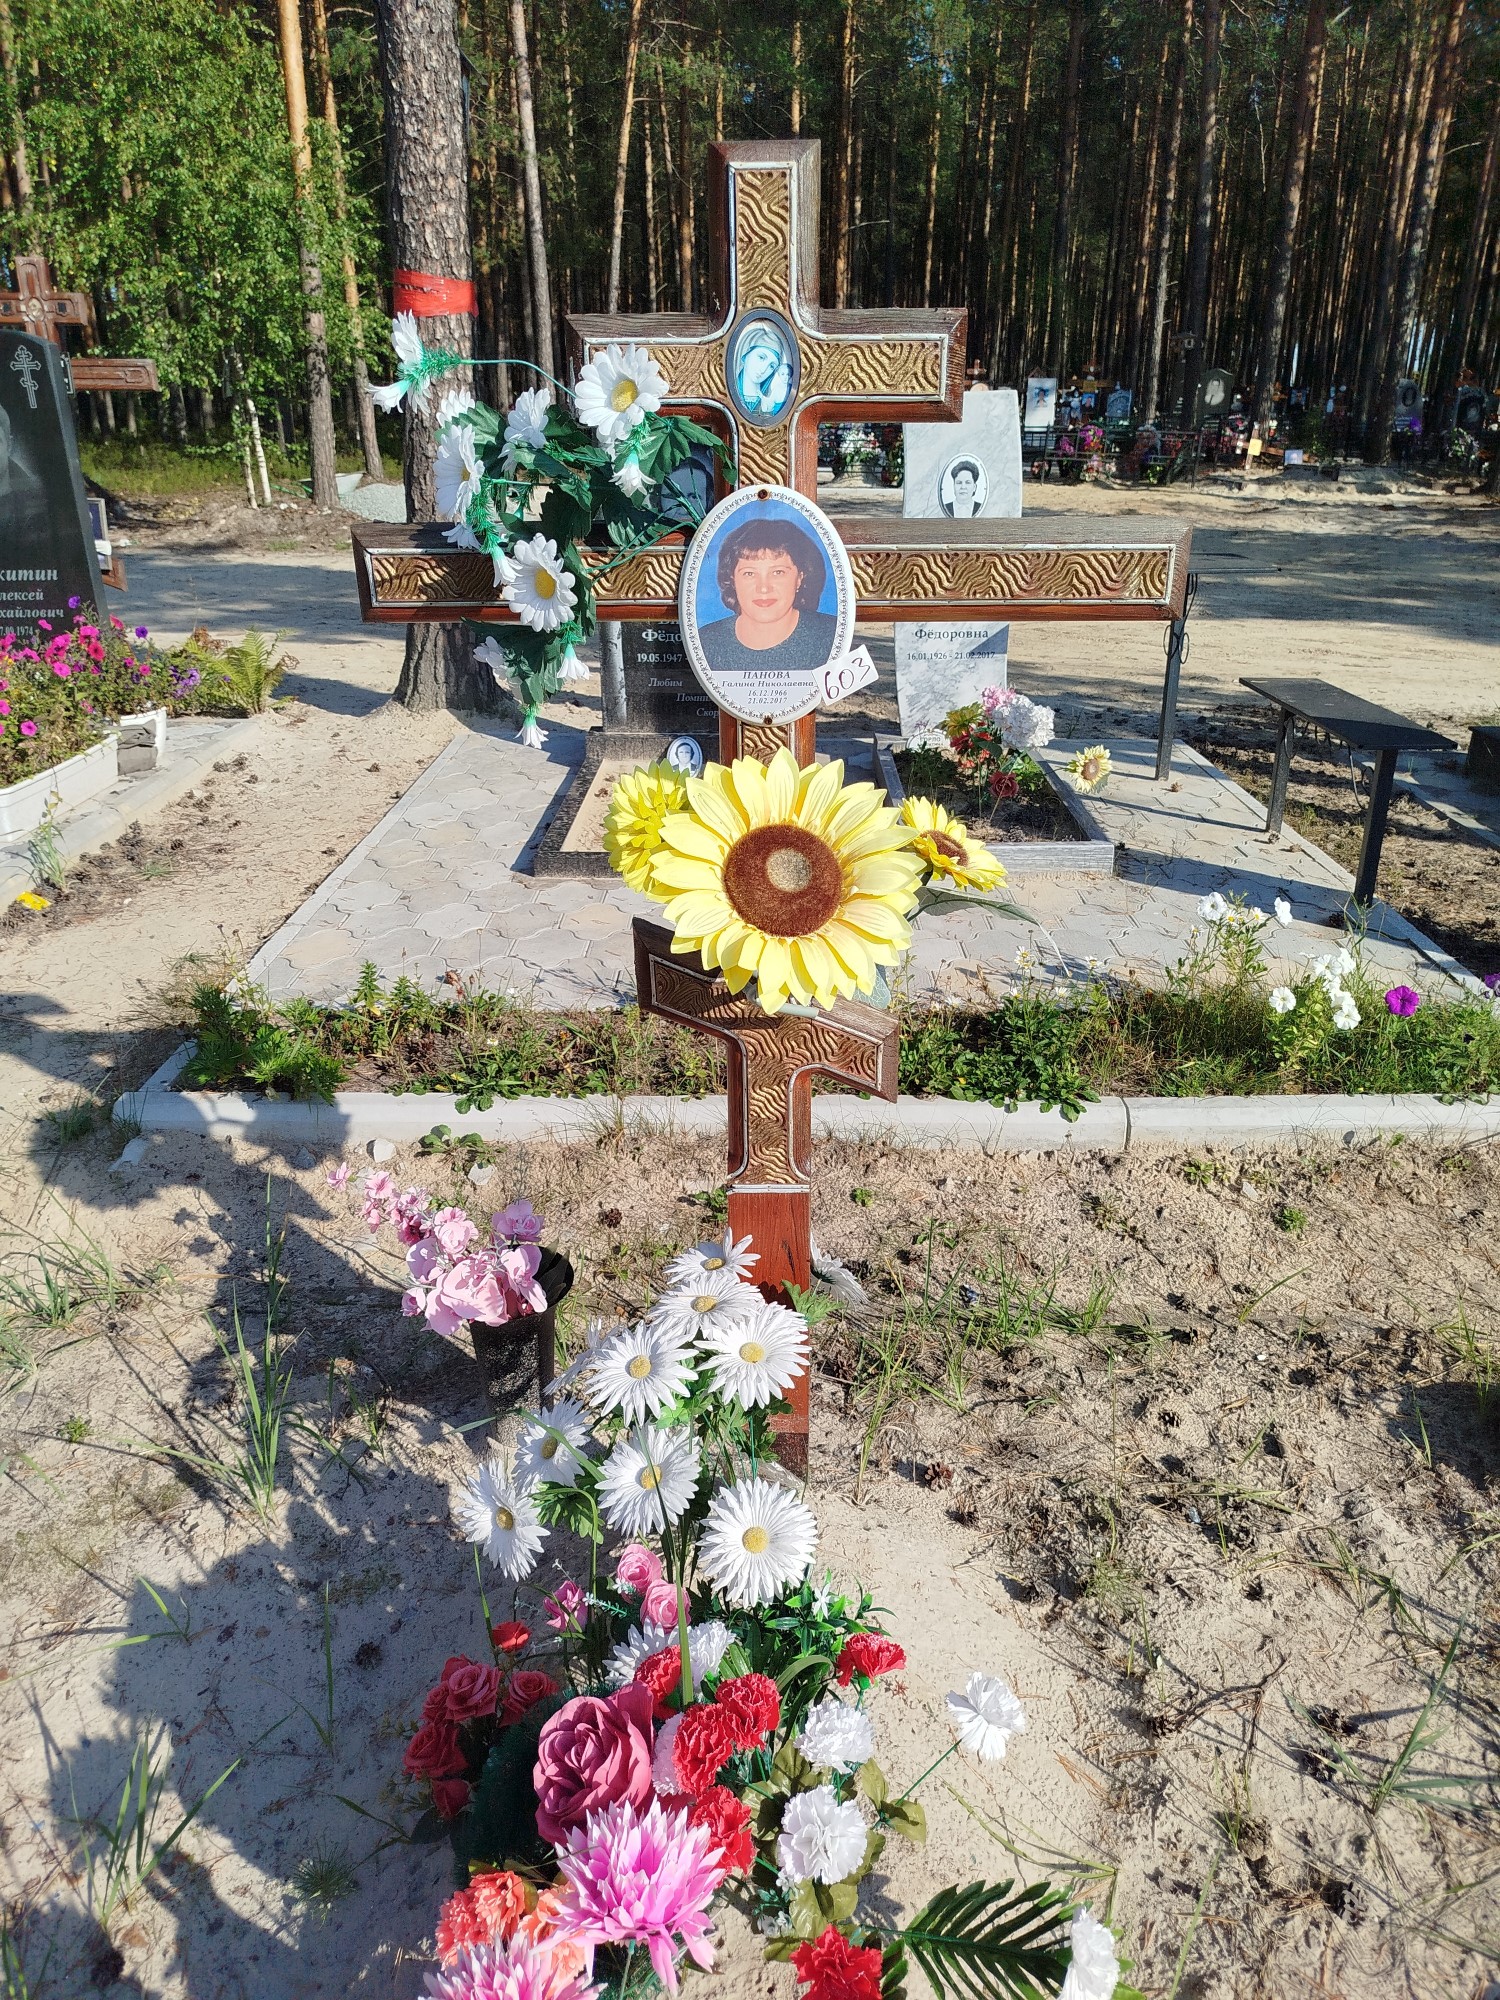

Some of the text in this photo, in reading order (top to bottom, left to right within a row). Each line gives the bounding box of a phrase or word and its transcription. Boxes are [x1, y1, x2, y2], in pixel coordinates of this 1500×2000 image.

[914, 628, 989, 641] Фёдоровна
[637, 653, 682, 663] 19.05.1947
[907, 652, 947, 661] 16.01.1926
[954, 651, 995, 660] 21.02.2017
[743, 671, 791, 680] ПАНОВА
[824, 657, 871, 700] 603
[648, 677, 683, 687] Любим
[722, 680, 814, 688] Галина Николаевна
